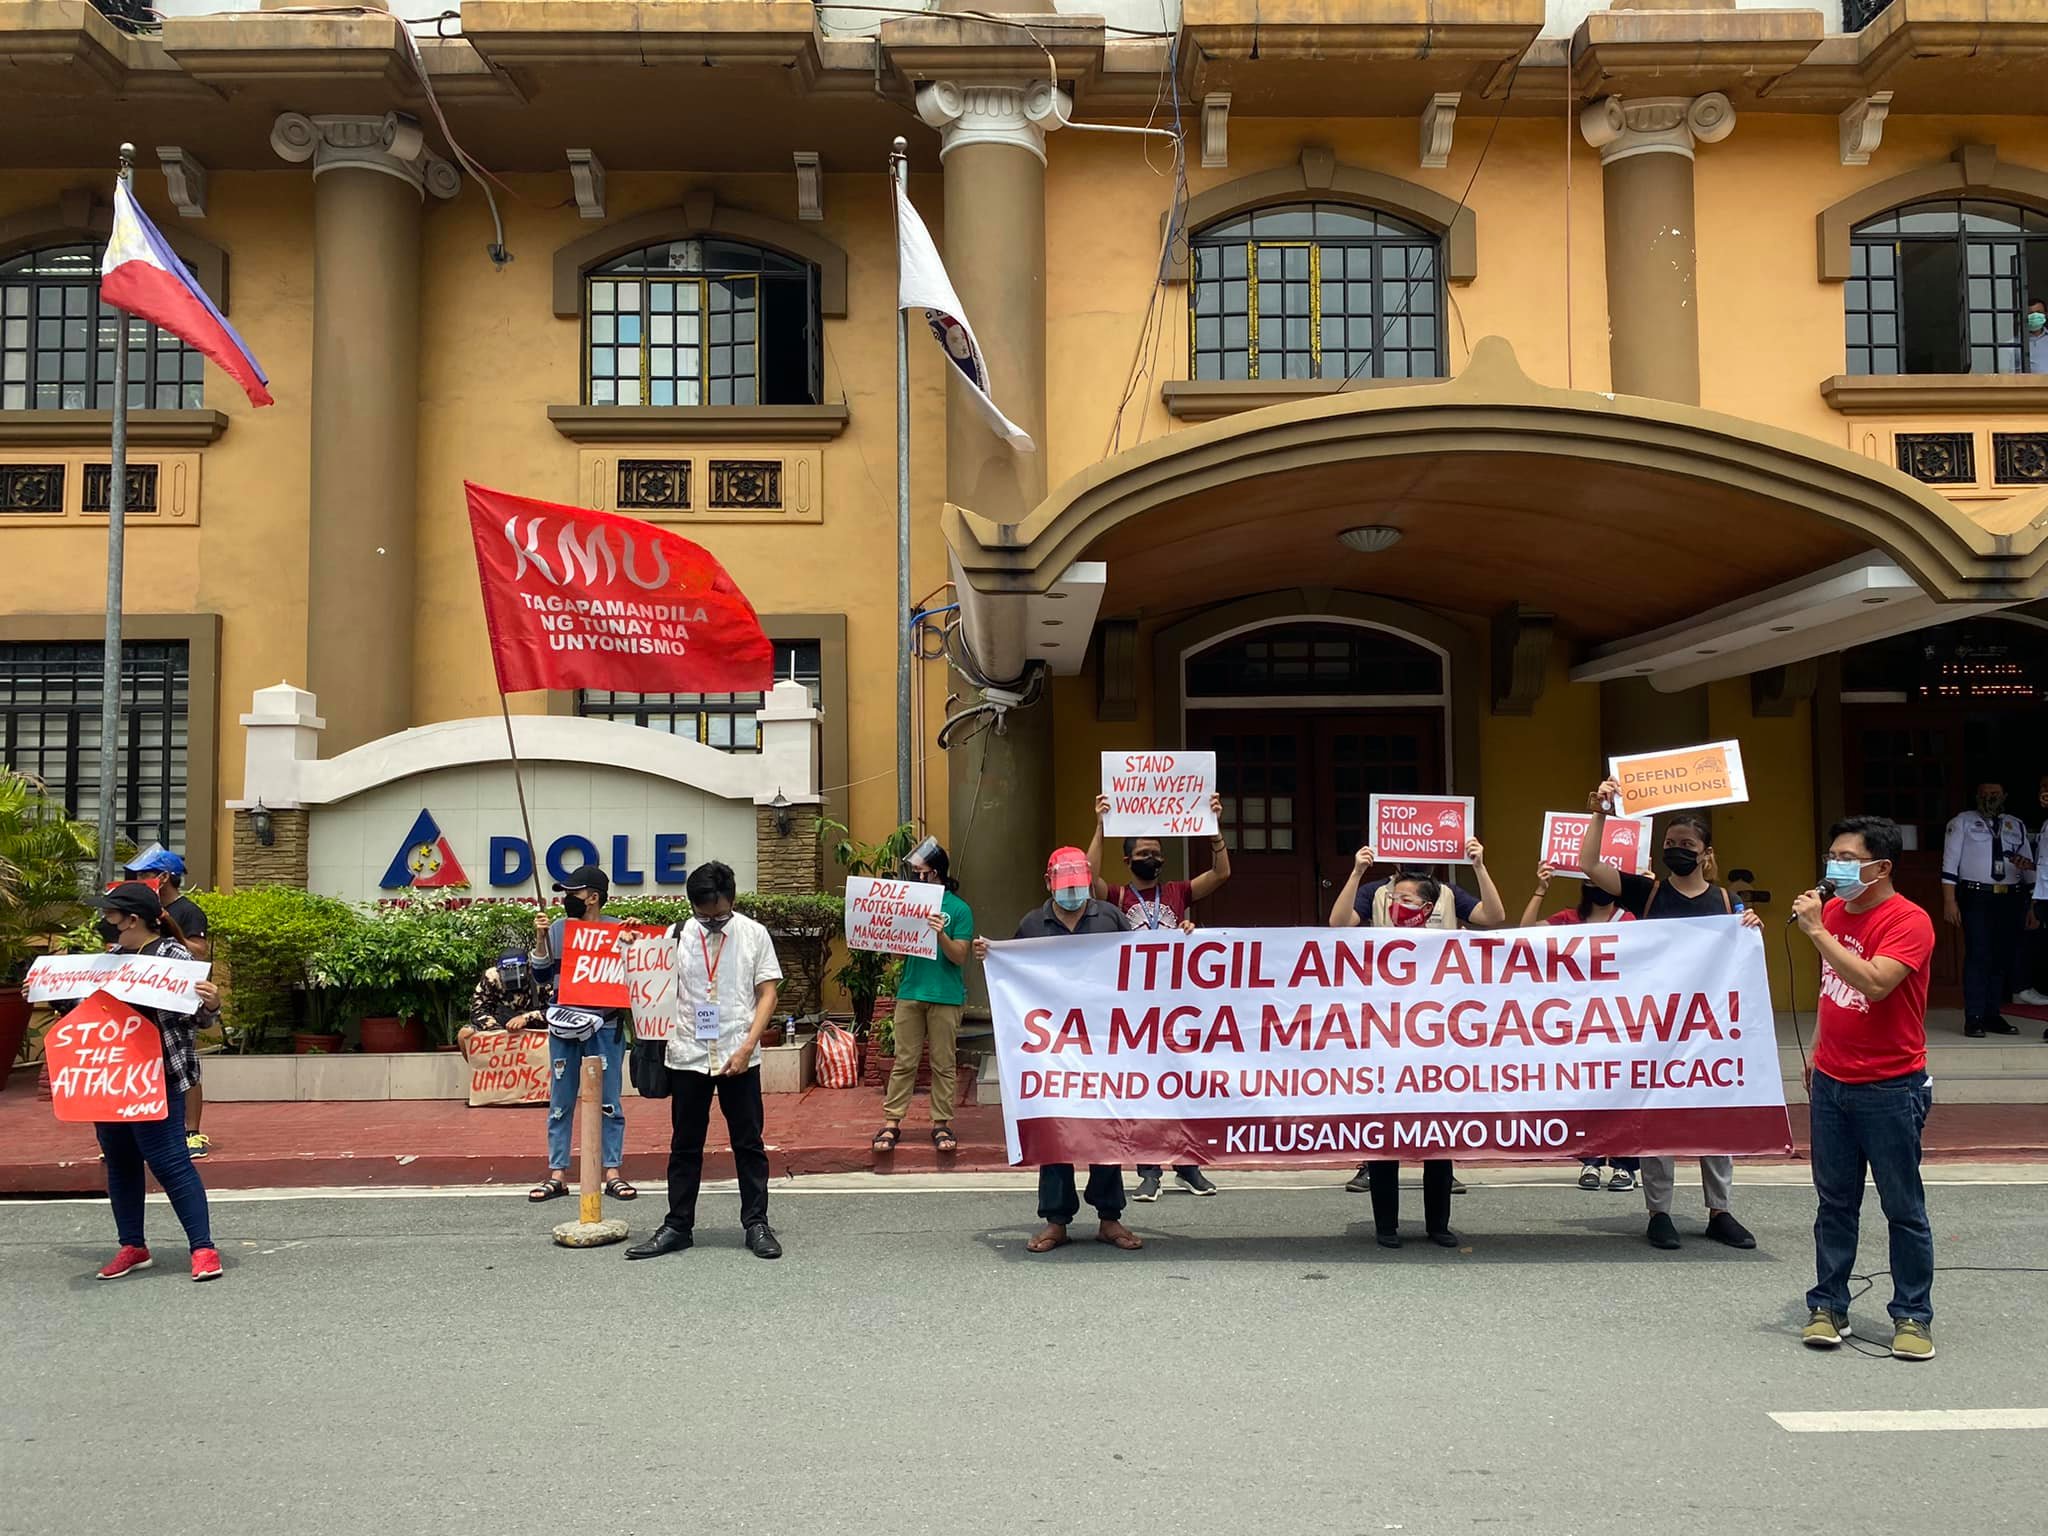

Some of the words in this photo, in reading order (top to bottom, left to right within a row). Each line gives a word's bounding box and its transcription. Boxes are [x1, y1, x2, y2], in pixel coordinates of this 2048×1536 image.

[505, 515, 671, 590] KMU
[520, 592, 709, 623] TAGAPAMANDILA
[540, 614, 574, 632] NG
[579, 616, 653, 636] TUNAY
[660, 622, 689, 640] NA
[549, 634, 686, 656] UNYONISMO
[1125, 755, 1175, 773] STAND
[1112, 776, 1147, 793] WITH
[1153, 776, 1204, 793] WYETH
[1624, 767, 1688, 784] DEFEND
[1626, 786, 1658, 801] OUR
[1663, 778, 1727, 794] UNIONS!
[1115, 796, 1201, 815] WORKERS!
[1381, 806, 1417, 820] STOP
[1163, 817, 1204, 833] -KMU
[1381, 822, 1434, 836] KILLING
[1381, 838, 1458, 853] UNIONISTS!
[1552, 837, 1581, 850] THE
[489, 833, 688, 886] DOLE
[868, 880, 910, 900] DOLE
[852, 898, 933, 920] PROTEKTAHAN
[869, 915, 893, 927] ANG
[852, 924, 930, 944] MANGGAGAWA!
[1844, 934, 1864, 953] MAYO
[626, 946, 675, 973] ELCAC
[1116, 941, 1275, 991] ITIGIL
[1287, 938, 1417, 989] ANG
[1430, 934, 1621, 986] ATAKE
[628, 978, 671, 1008] AS!
[1820, 974, 1854, 1008] MU
[550, 1009, 589, 1026] NIKE
[1020, 1007, 1093, 1055] SA
[1107, 1004, 1246, 1055] MGA
[1259, 991, 1742, 1052] MANGGAGAWA!
[53, 1016, 142, 1047] STOP
[469, 1032, 548, 1055] DEFEND
[75, 1046, 126, 1066] THE
[488, 1053, 528, 1068] OUR
[52, 1057, 163, 1098] ATTACKS!
[1019, 1070, 1150, 1100] DEFEND
[1156, 1069, 1231, 1098] OUR
[1240, 1066, 1386, 1097] UNIONS!
[1394, 1063, 1546, 1094] ABOLISH
[1556, 1059, 1622, 1091] NTF
[1630, 1057, 1745, 1089] ELCAC!
[116, 1100, 166, 1118] -KMU
[1225, 1120, 1385, 1153] KILUSANG
[1392, 1119, 1489, 1148] MAYO
[1494, 1118, 1569, 1147] UNO
